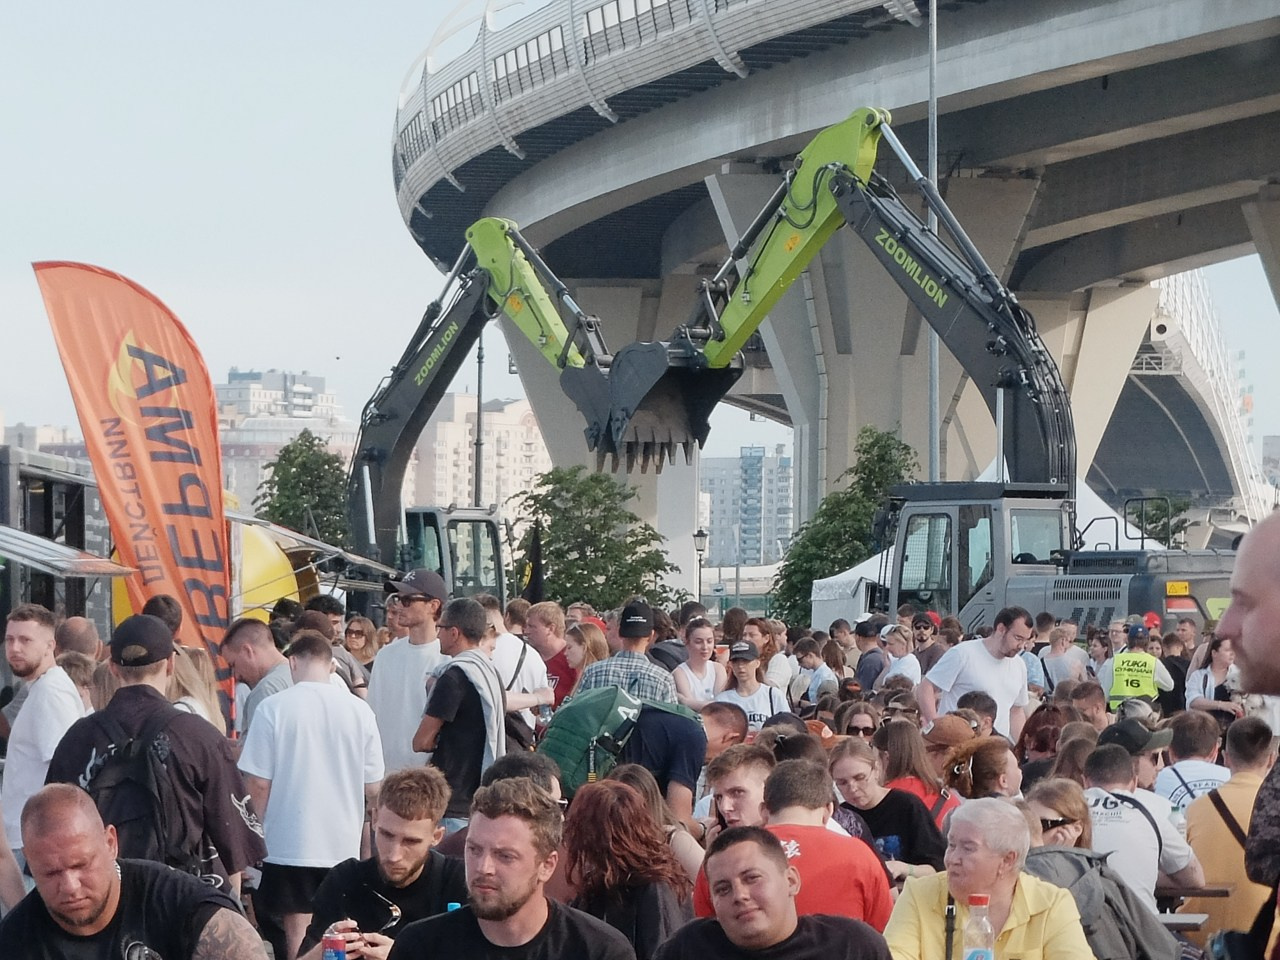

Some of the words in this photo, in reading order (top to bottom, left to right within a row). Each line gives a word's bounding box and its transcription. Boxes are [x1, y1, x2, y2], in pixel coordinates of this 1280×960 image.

[875, 227, 948, 308] ZOOMLION
[414, 321, 459, 386] ZOOMLION
[1121, 660, 1147, 668] YUKA
[1124, 678, 1141, 688] 16
